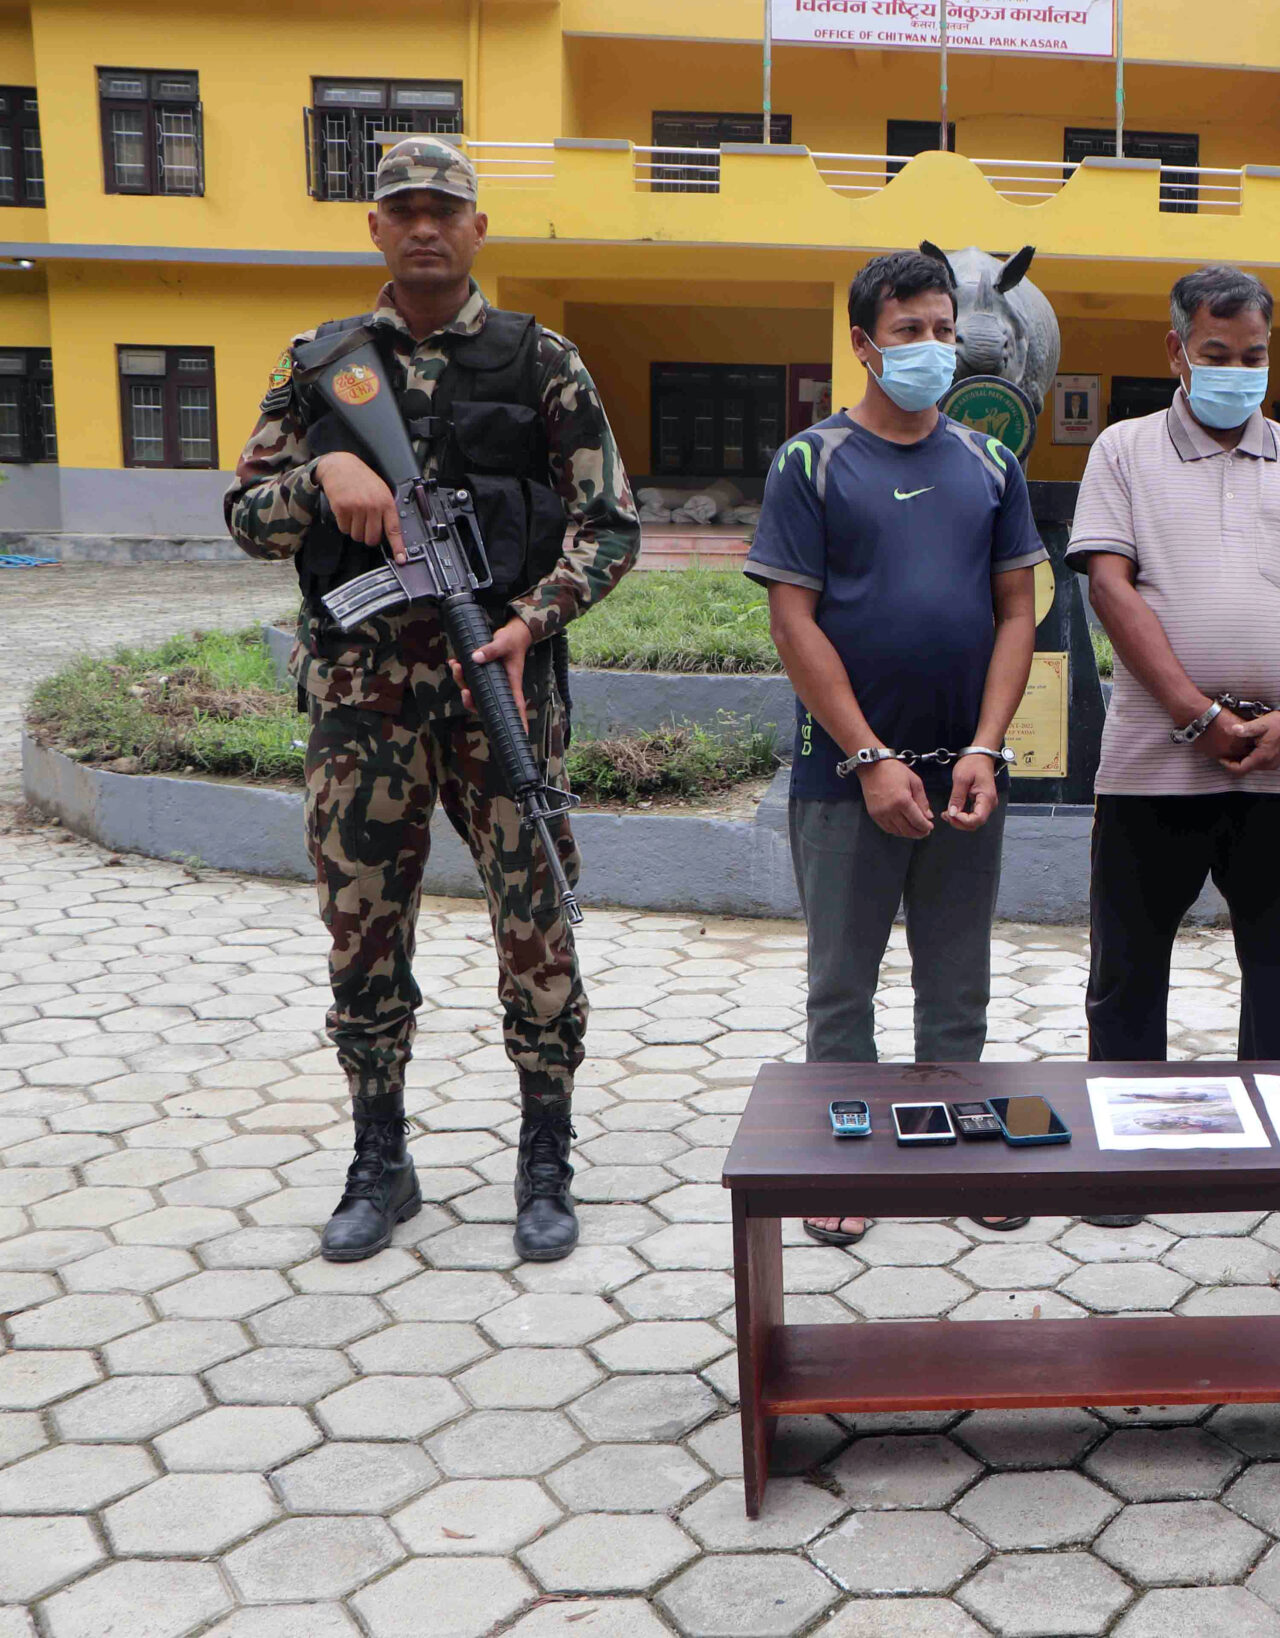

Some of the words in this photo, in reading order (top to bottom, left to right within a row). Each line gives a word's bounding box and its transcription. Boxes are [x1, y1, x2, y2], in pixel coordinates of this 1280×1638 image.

[1009, 6, 1088, 25] कार्यालय
[814, 29, 855, 40] OFFICE
[859, 31, 873, 40] OF
[877, 32, 927, 42] CHITWAN
[1020, 38, 1068, 49] KASARA
